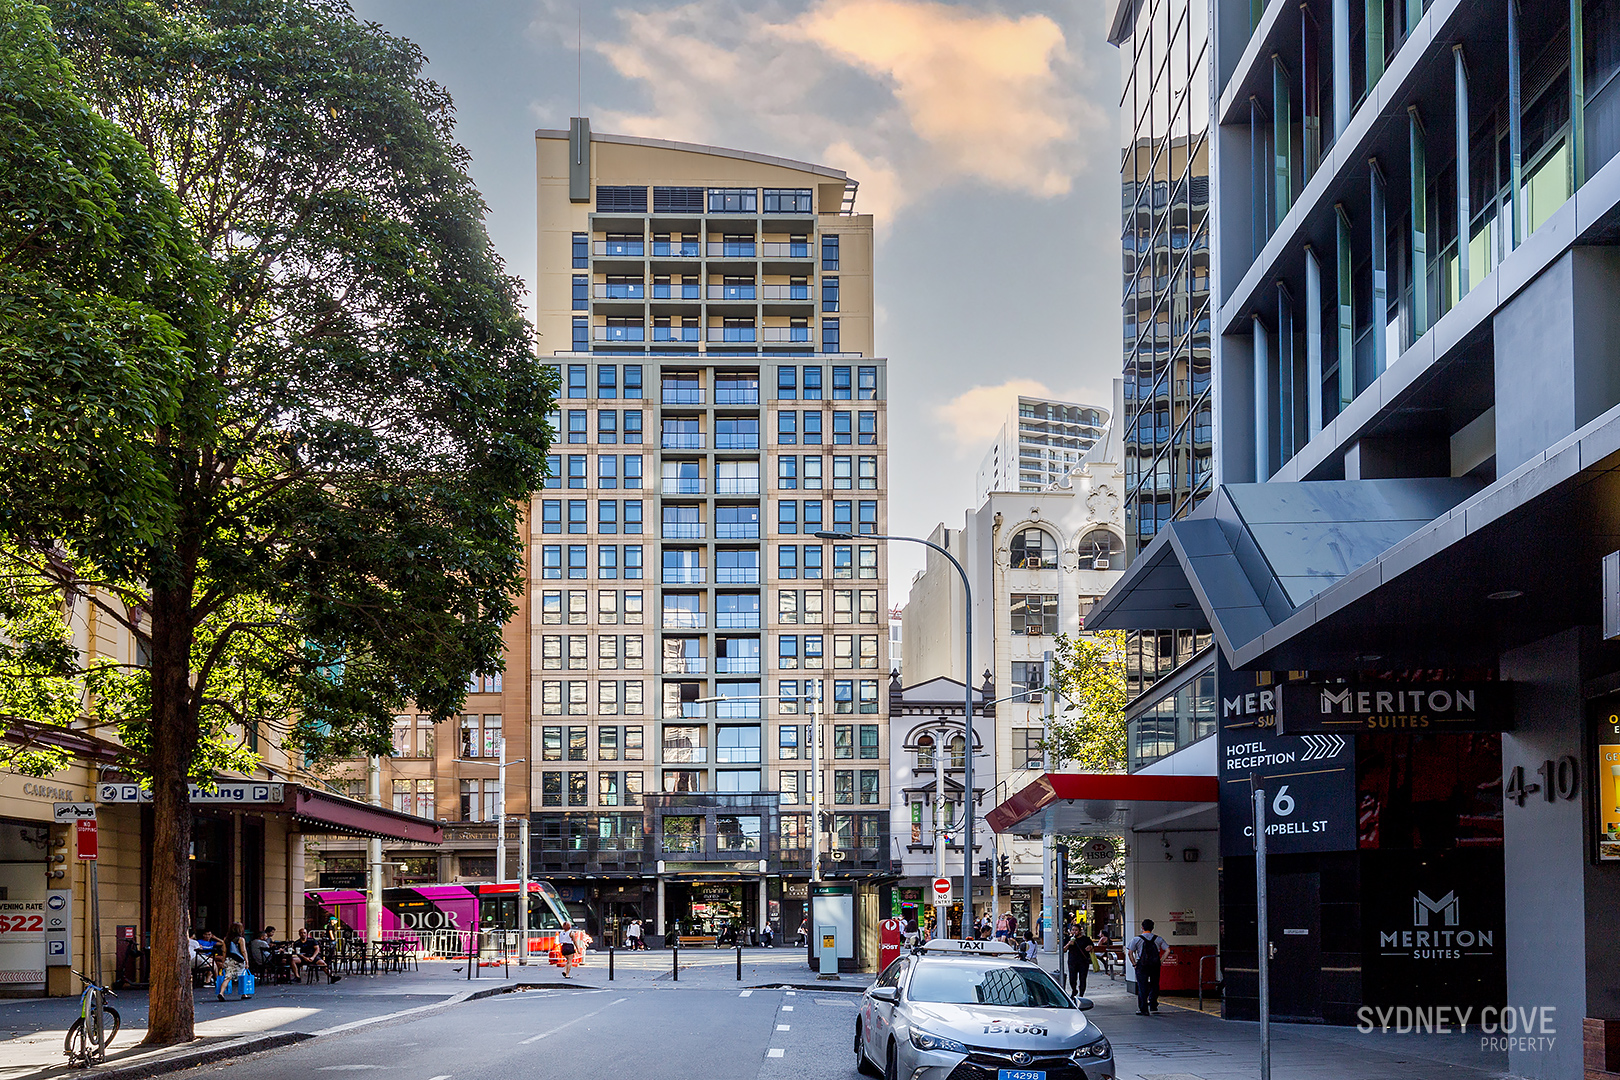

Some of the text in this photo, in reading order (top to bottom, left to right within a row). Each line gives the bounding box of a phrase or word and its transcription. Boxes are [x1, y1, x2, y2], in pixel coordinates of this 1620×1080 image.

[1321, 688, 1475, 714] MERITON
[1367, 715, 1430, 729] SUITES
[1226, 741, 1267, 756] HOTEL
[1227, 751, 1296, 770] RECEPTION
[1505, 755, 1580, 807] 4-10
[23, 782, 73, 802] CARPARK
[192, 786, 244, 801] rking
[1272, 785, 1296, 817] 6
[1243, 820, 1328, 838] CMPBELL ST
[1086, 852, 1114, 861] HSBC
[400, 911, 460, 929] DIOR
[957, 941, 985, 950] TAXI
[1380, 930, 1493, 948] MERITON
[1413, 949, 1461, 959] SUITES
